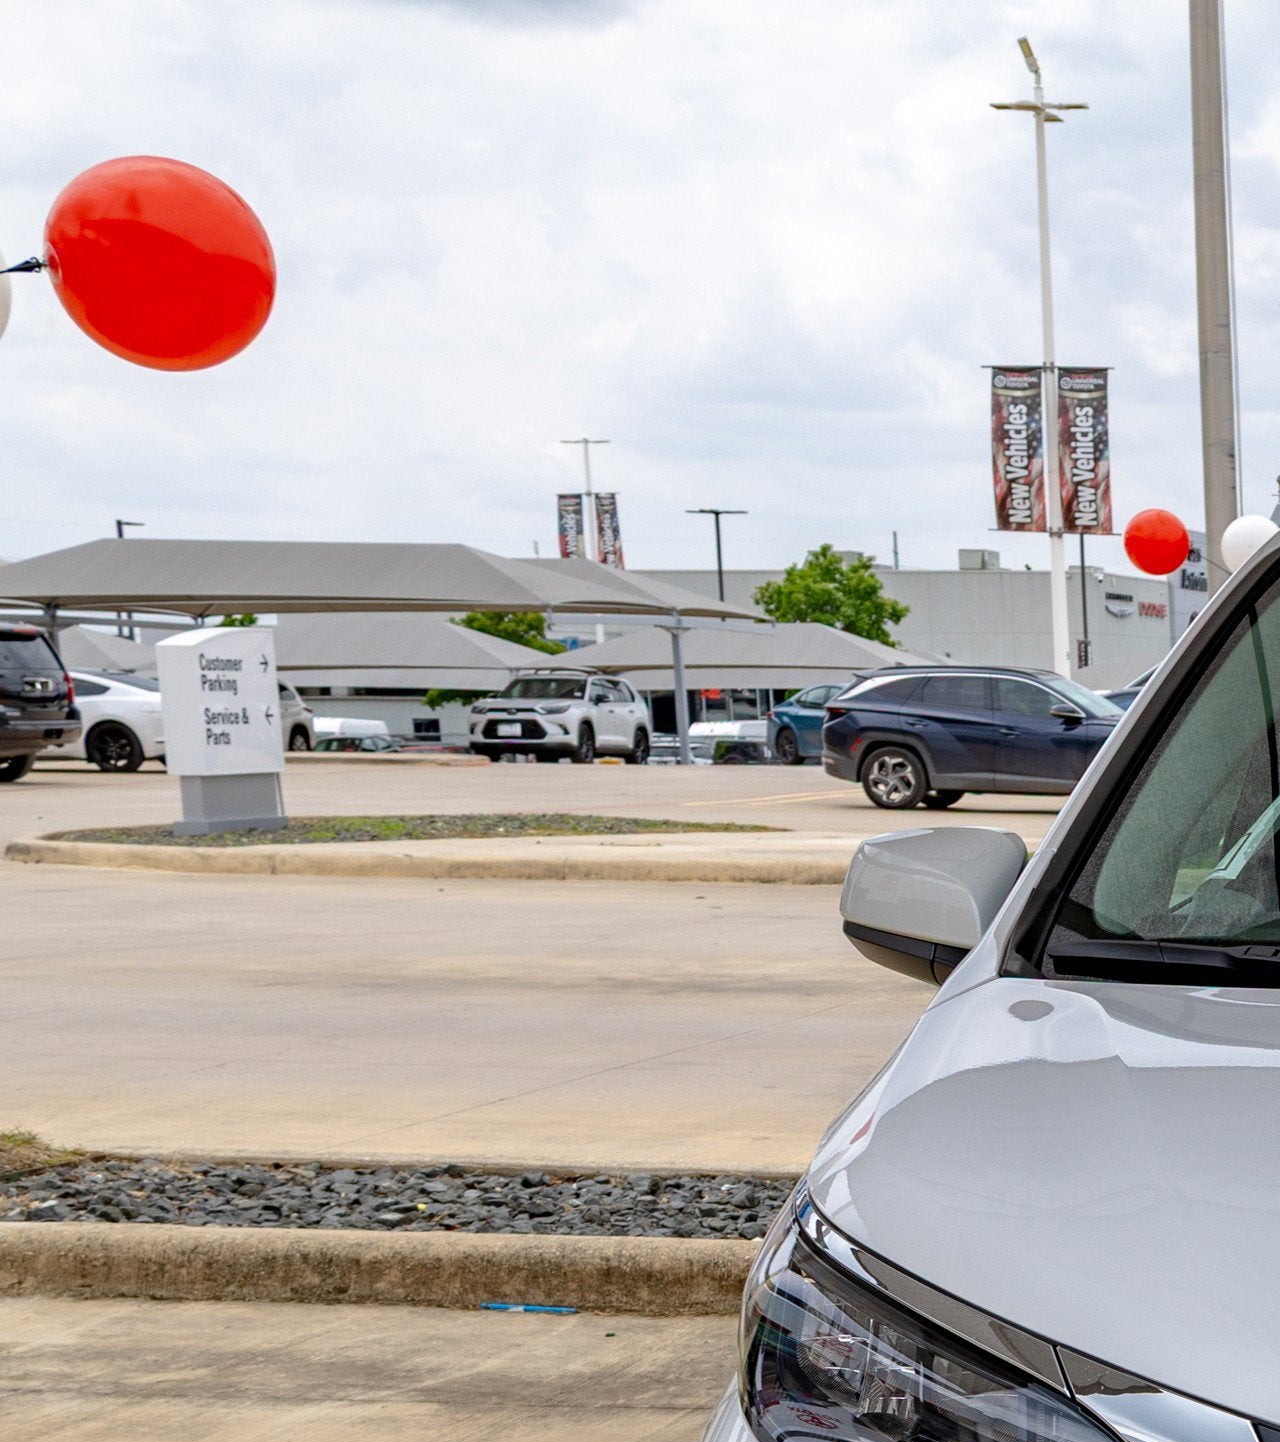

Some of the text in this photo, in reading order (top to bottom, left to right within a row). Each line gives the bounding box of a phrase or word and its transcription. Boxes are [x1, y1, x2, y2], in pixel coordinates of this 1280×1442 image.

[1003, 403, 1029, 480] Vehicles
[1070, 406, 1096, 482] Vehicles
[1008, 484, 1031, 523] New
[1074, 485, 1098, 526] New
[199, 653, 242, 672] Customer
[201, 674, 238, 696] Parking
[204, 707, 249, 725] Service &
[206, 728, 231, 745] Parts
